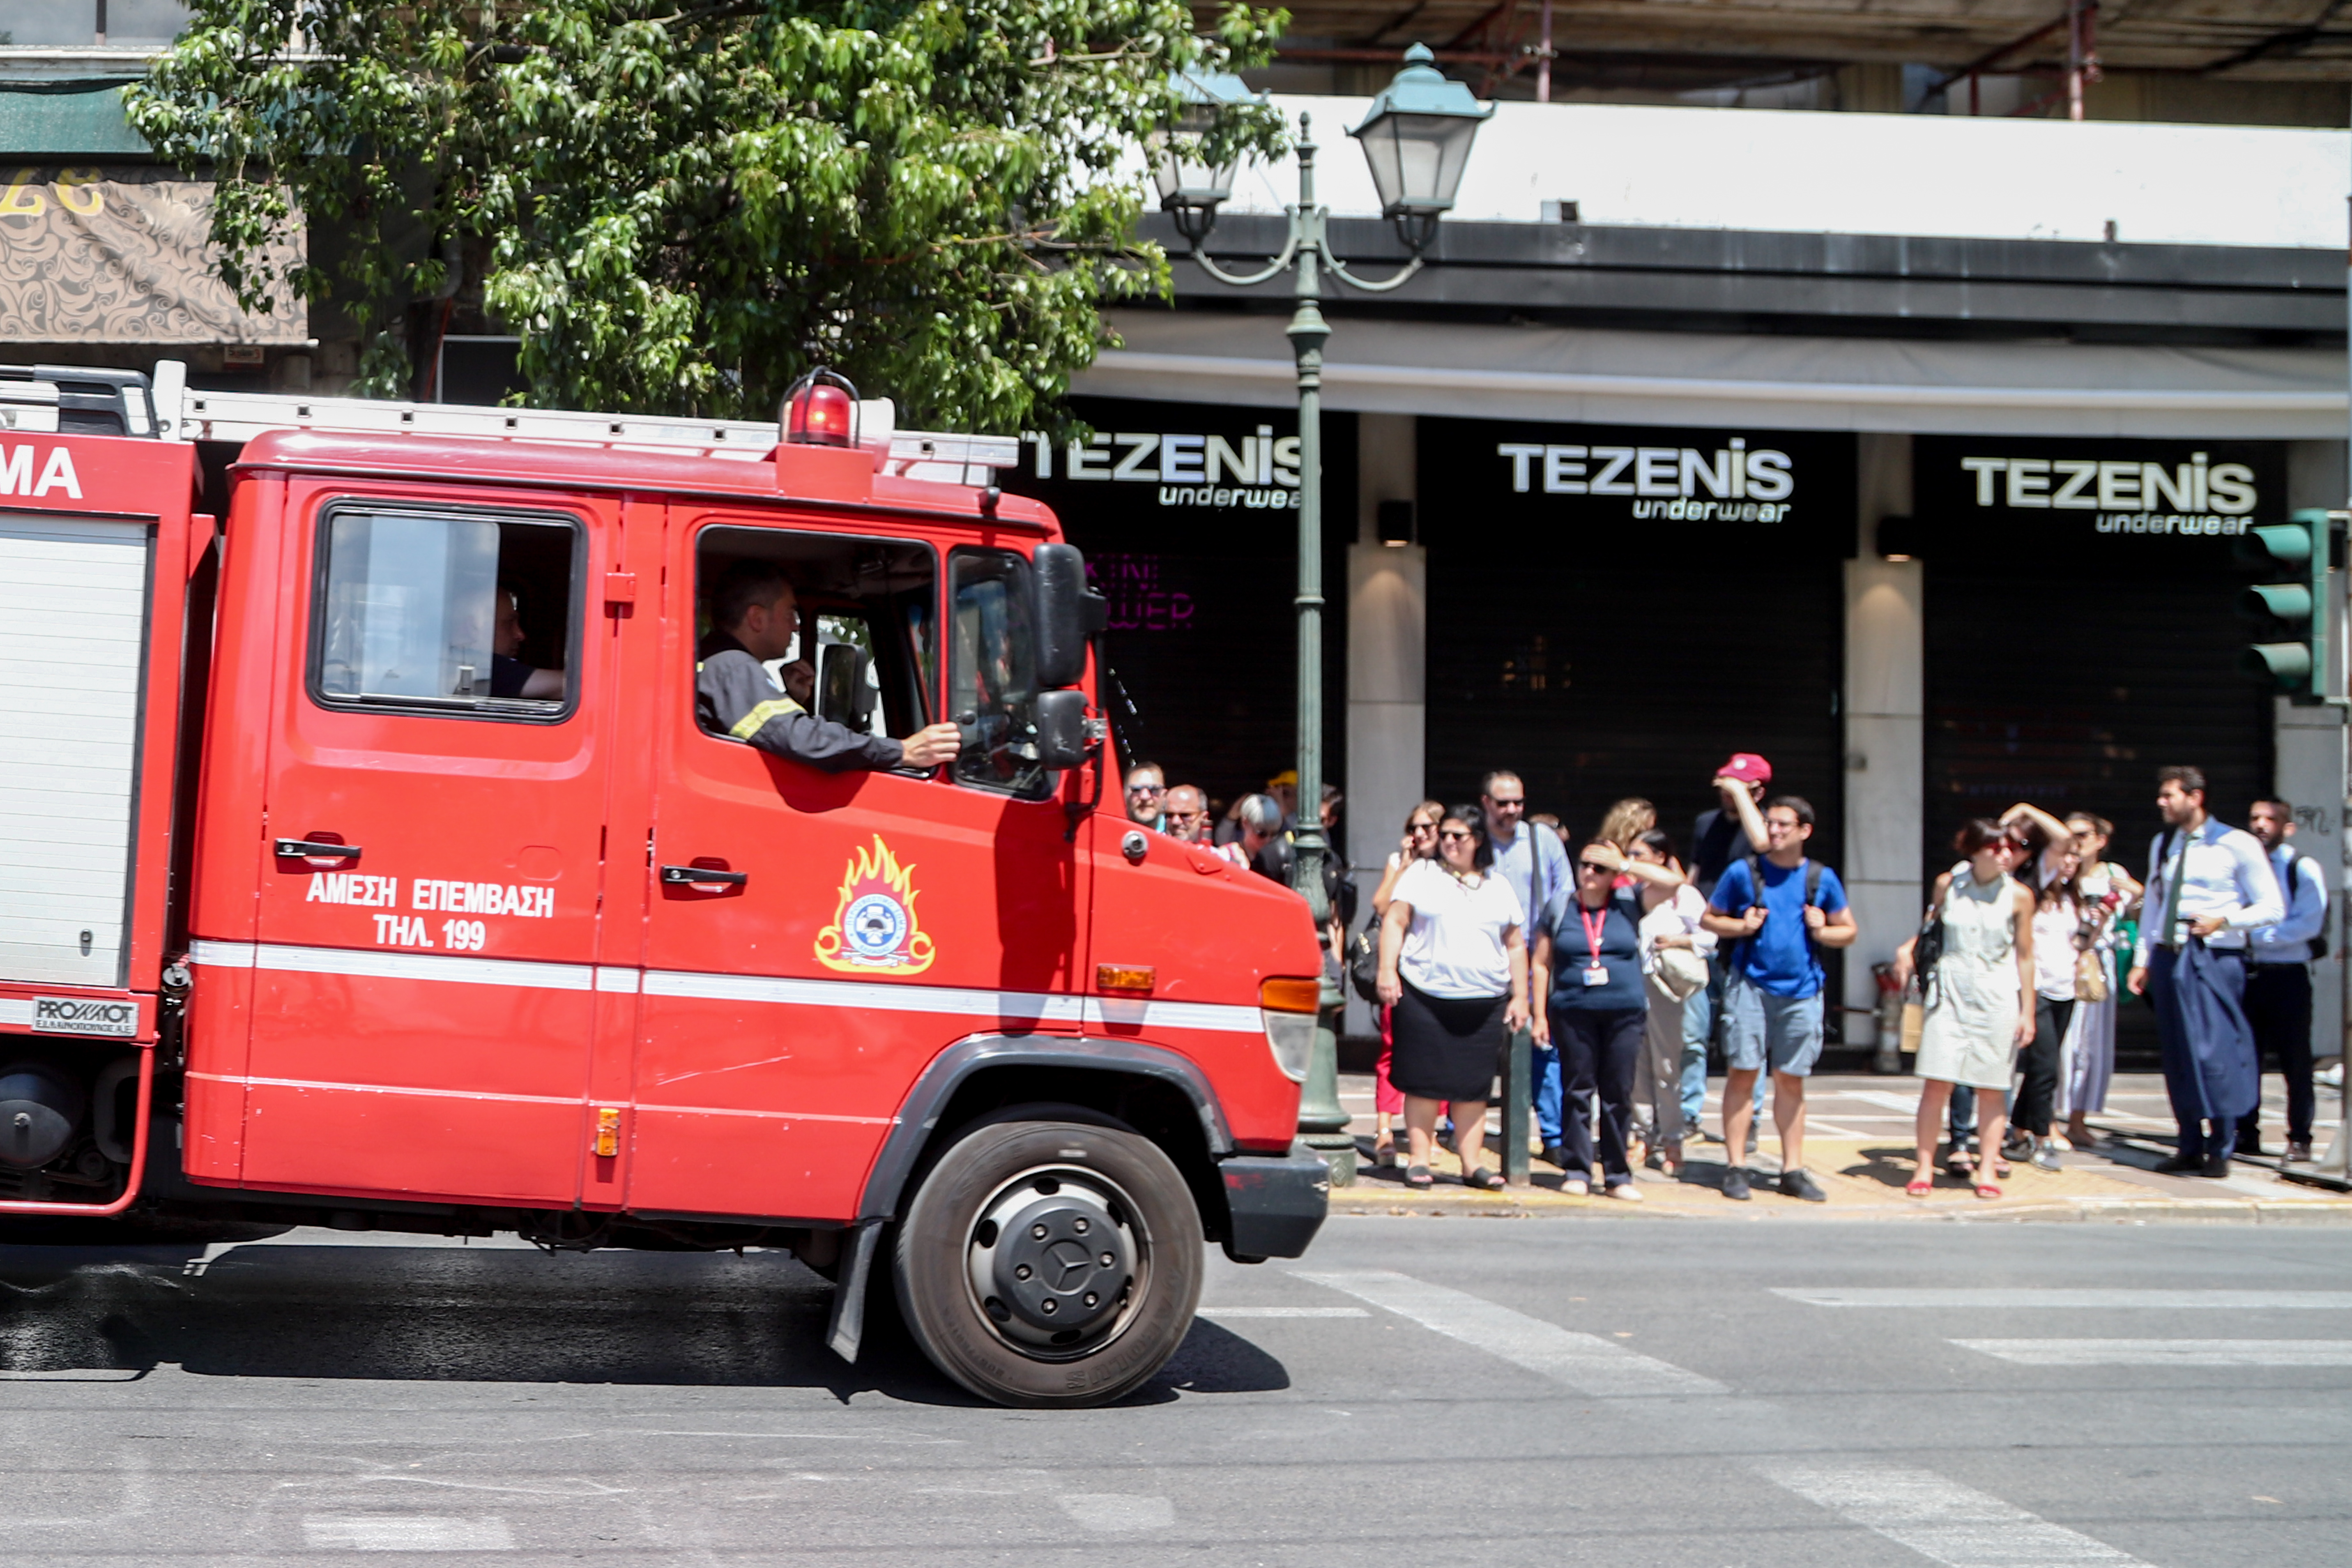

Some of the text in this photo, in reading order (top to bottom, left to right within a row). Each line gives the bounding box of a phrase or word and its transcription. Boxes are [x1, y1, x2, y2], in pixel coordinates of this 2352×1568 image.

[1159, 484, 1300, 509] underwea
[1632, 497, 1791, 523] underwear
[2095, 513, 2253, 535] underwear
[306, 872, 555, 918] ΑΜΕΣΗ ΕΠΕΜΒΑΣΗ
[373, 914, 486, 950] ΤΗΛ. 199
